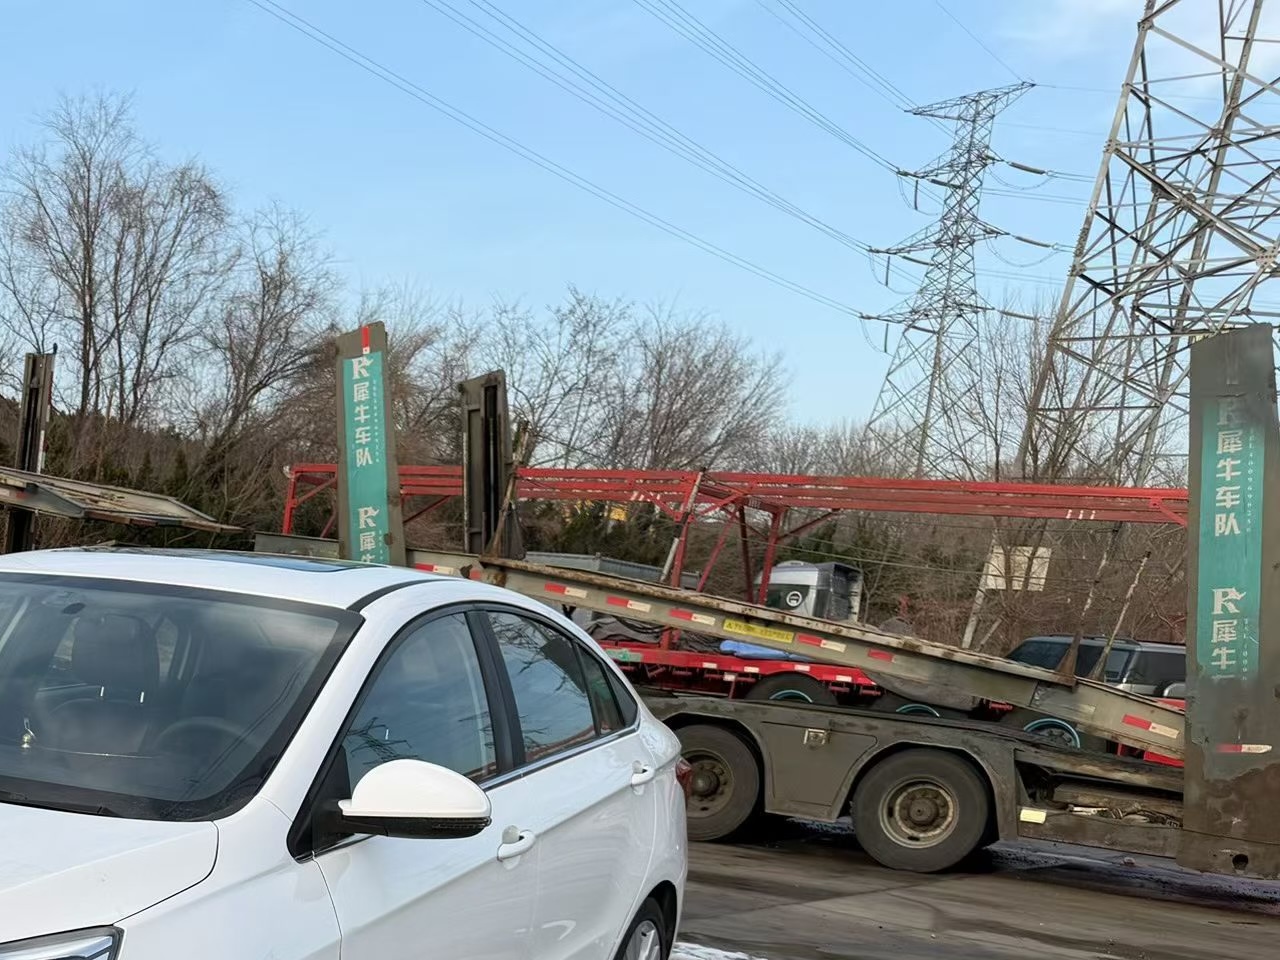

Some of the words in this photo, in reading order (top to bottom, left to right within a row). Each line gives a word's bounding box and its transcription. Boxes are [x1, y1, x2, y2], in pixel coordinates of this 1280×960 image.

[353, 381, 373, 467] 犀牛车队
[1214, 430, 1243, 537] 犀牛车队
[1211, 619, 1238, 684] 犀牛
